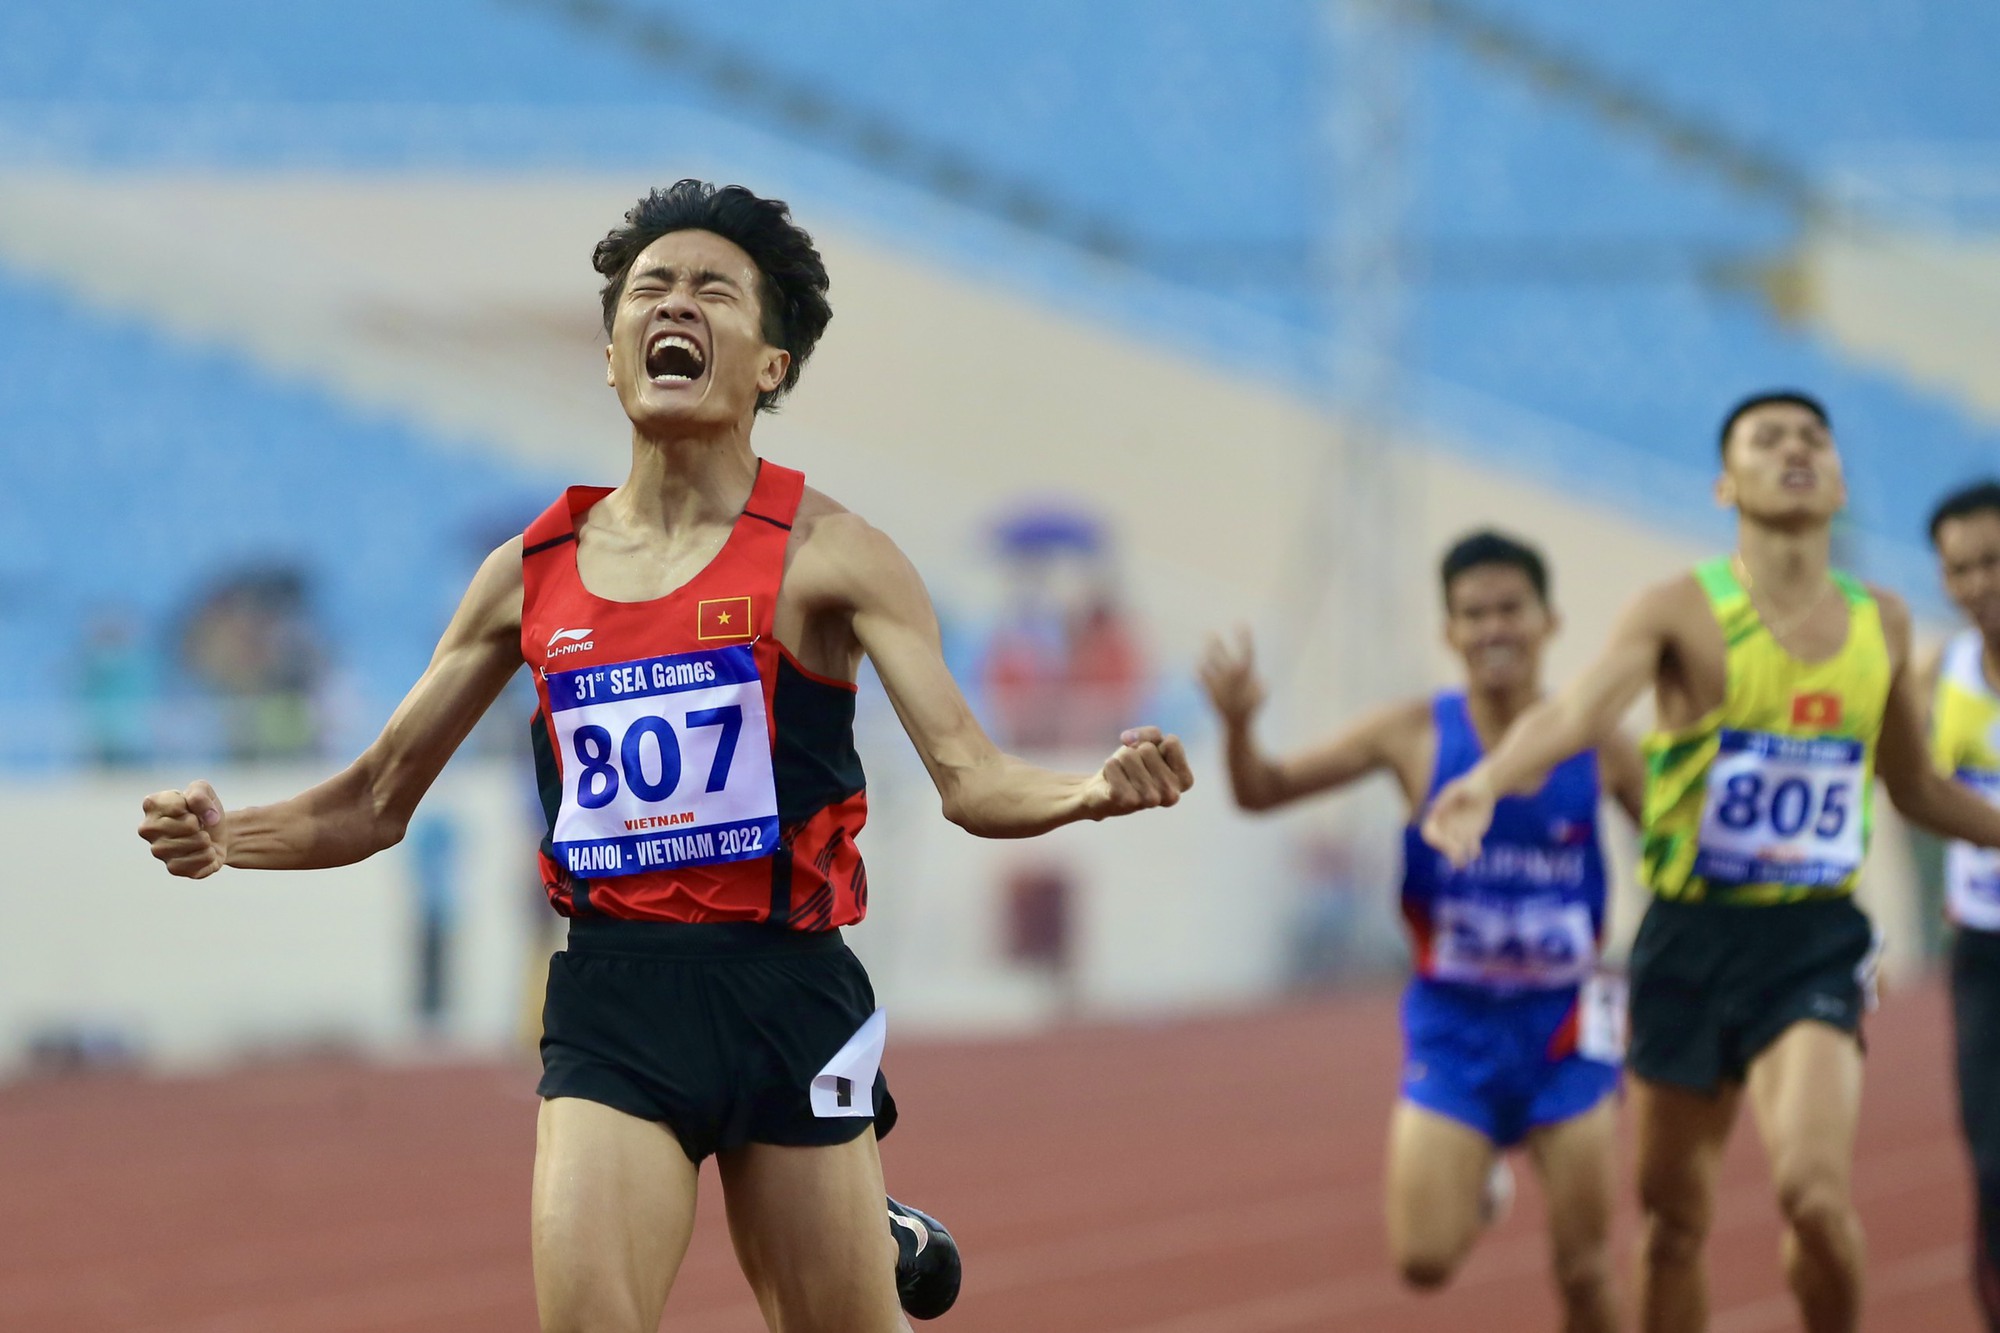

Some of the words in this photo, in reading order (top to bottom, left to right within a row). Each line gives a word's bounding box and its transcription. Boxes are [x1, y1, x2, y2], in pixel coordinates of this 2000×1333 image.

[547, 641, 594, 658] LI-NING
[574, 672, 605, 700] 31ST
[610, 665, 648, 695] SEA
[652, 660, 716, 689] Games
[573, 704, 743, 809] 807
[624, 811, 695, 831] VIETNAM
[1717, 773, 1848, 839] 805
[568, 844, 622, 872] HANOI
[635, 832, 715, 867] VIETNAM
[718, 826, 763, 855] 2022
